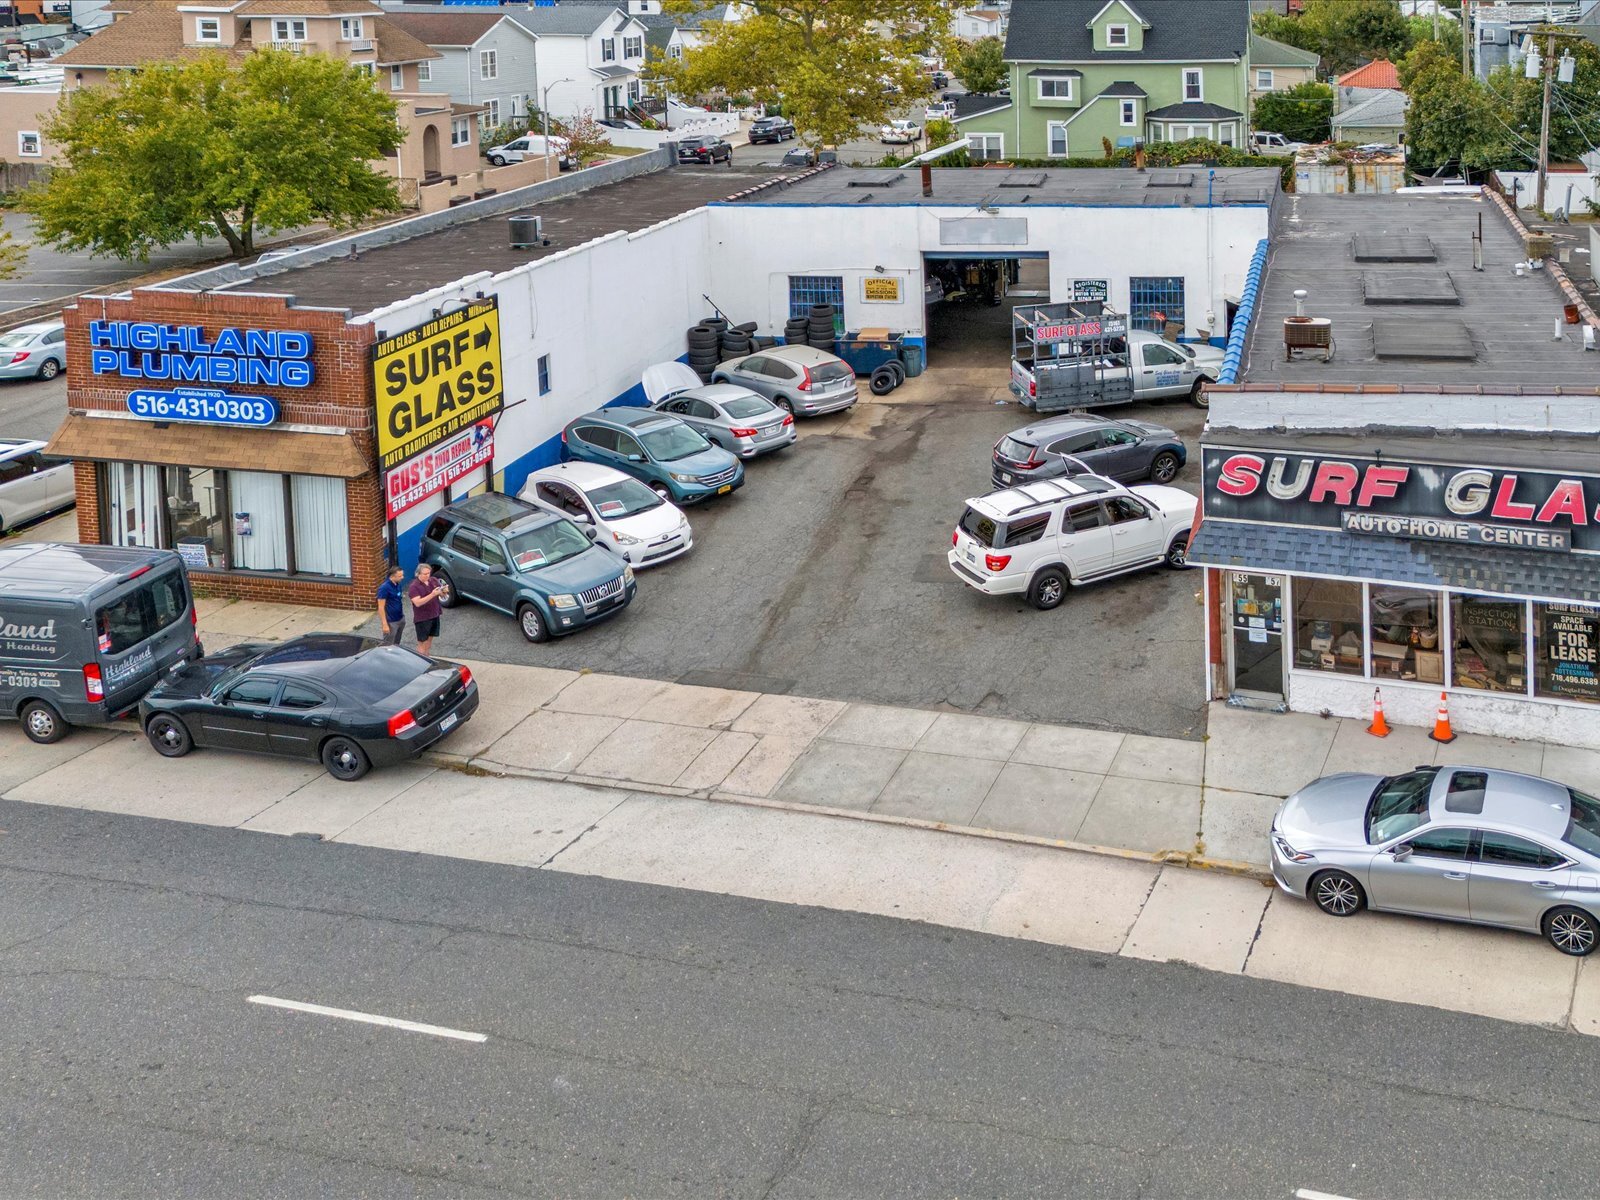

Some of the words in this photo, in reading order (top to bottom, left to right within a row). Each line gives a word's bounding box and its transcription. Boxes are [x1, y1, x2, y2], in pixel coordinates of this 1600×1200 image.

[868, 278, 895, 286] OFFICIAL
[1075, 280, 1106, 288] REGISTERED
[378, 341, 395, 358] AUTO
[396, 330, 417, 349] GLASS
[422, 321, 438, 338] AUTO
[439, 311, 464, 331] REPAIRS
[1037, 325, 1065, 339] SURF
[89, 320, 313, 359] HIGHLAND
[92, 349, 313, 388] PLUMBING
[385, 329, 470, 396] SURF
[177, 390, 206, 398] Established
[388, 361, 495, 439] GLASS
[136, 395, 265, 421] 516-431-0303
[385, 449, 403, 468] AUTO
[404, 427, 441, 457] RADIATORS
[448, 418, 459, 433] AIR
[460, 395, 500, 424] CONDITIONING
[390, 454, 434, 497] GUS'S
[435, 447, 450, 470] AUTO
[451, 437, 471, 459] REPAIR
[1216, 453, 1410, 507] SURF
[1444, 469, 1600, 526] GLA
[1346, 513, 1469, 540] AUTO-HOME
[1480, 527, 1565, 548] CENTER
[1238, 574, 1248, 582] 55
[1270, 578, 1280, 586] 57
[1463, 607, 1516, 619] INSPECTION
[1549, 601, 1569, 611] SURF
[1570, 603, 1594, 614] GLASS
[1468, 616, 1512, 627] STATION
[1560, 615, 1584, 625] SPACE
[1553, 622, 1593, 633] AVAILABLE
[1558, 631, 1588, 648] FOR
[6, 641, 56, 654] Heating
[1550, 645, 1597, 663] LEASE
[1554, 667, 1594, 678] GOTTESMANN
[1558, 661, 1590, 671] JONATHAN
[1551, 673, 1599, 686] 718.496.6389
